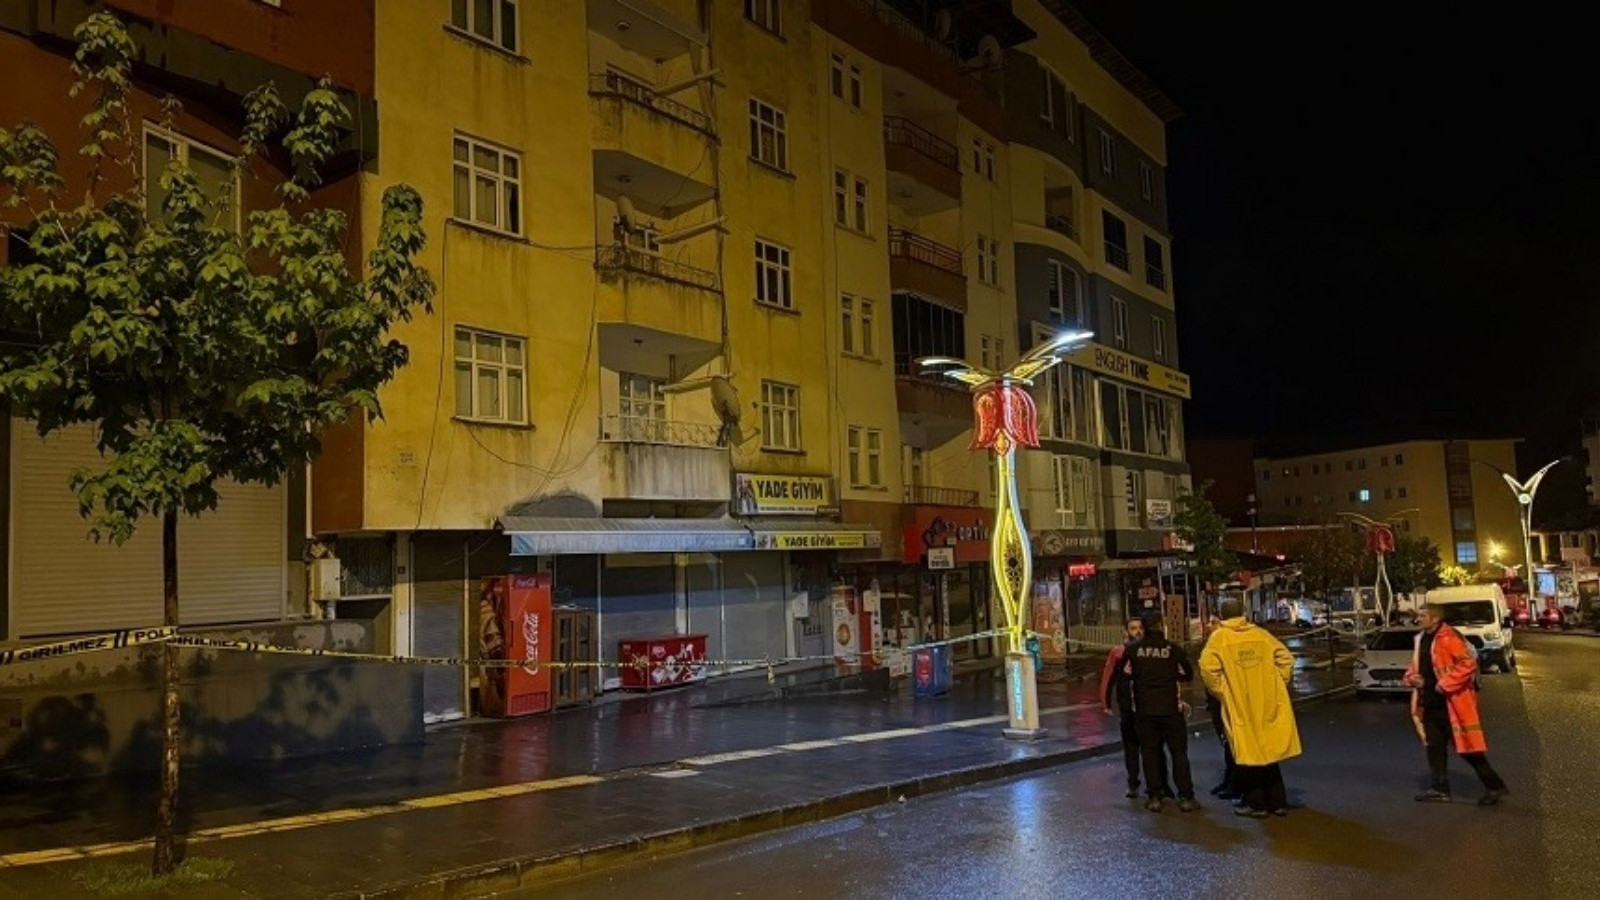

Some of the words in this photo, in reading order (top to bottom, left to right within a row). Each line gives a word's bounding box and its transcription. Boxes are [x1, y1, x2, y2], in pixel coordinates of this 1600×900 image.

[1095, 348, 1129, 377] ENGLISH
[756, 480, 789, 499] YADE
[784, 536, 808, 547] YADE
[1137, 646, 1170, 658] AFAD
